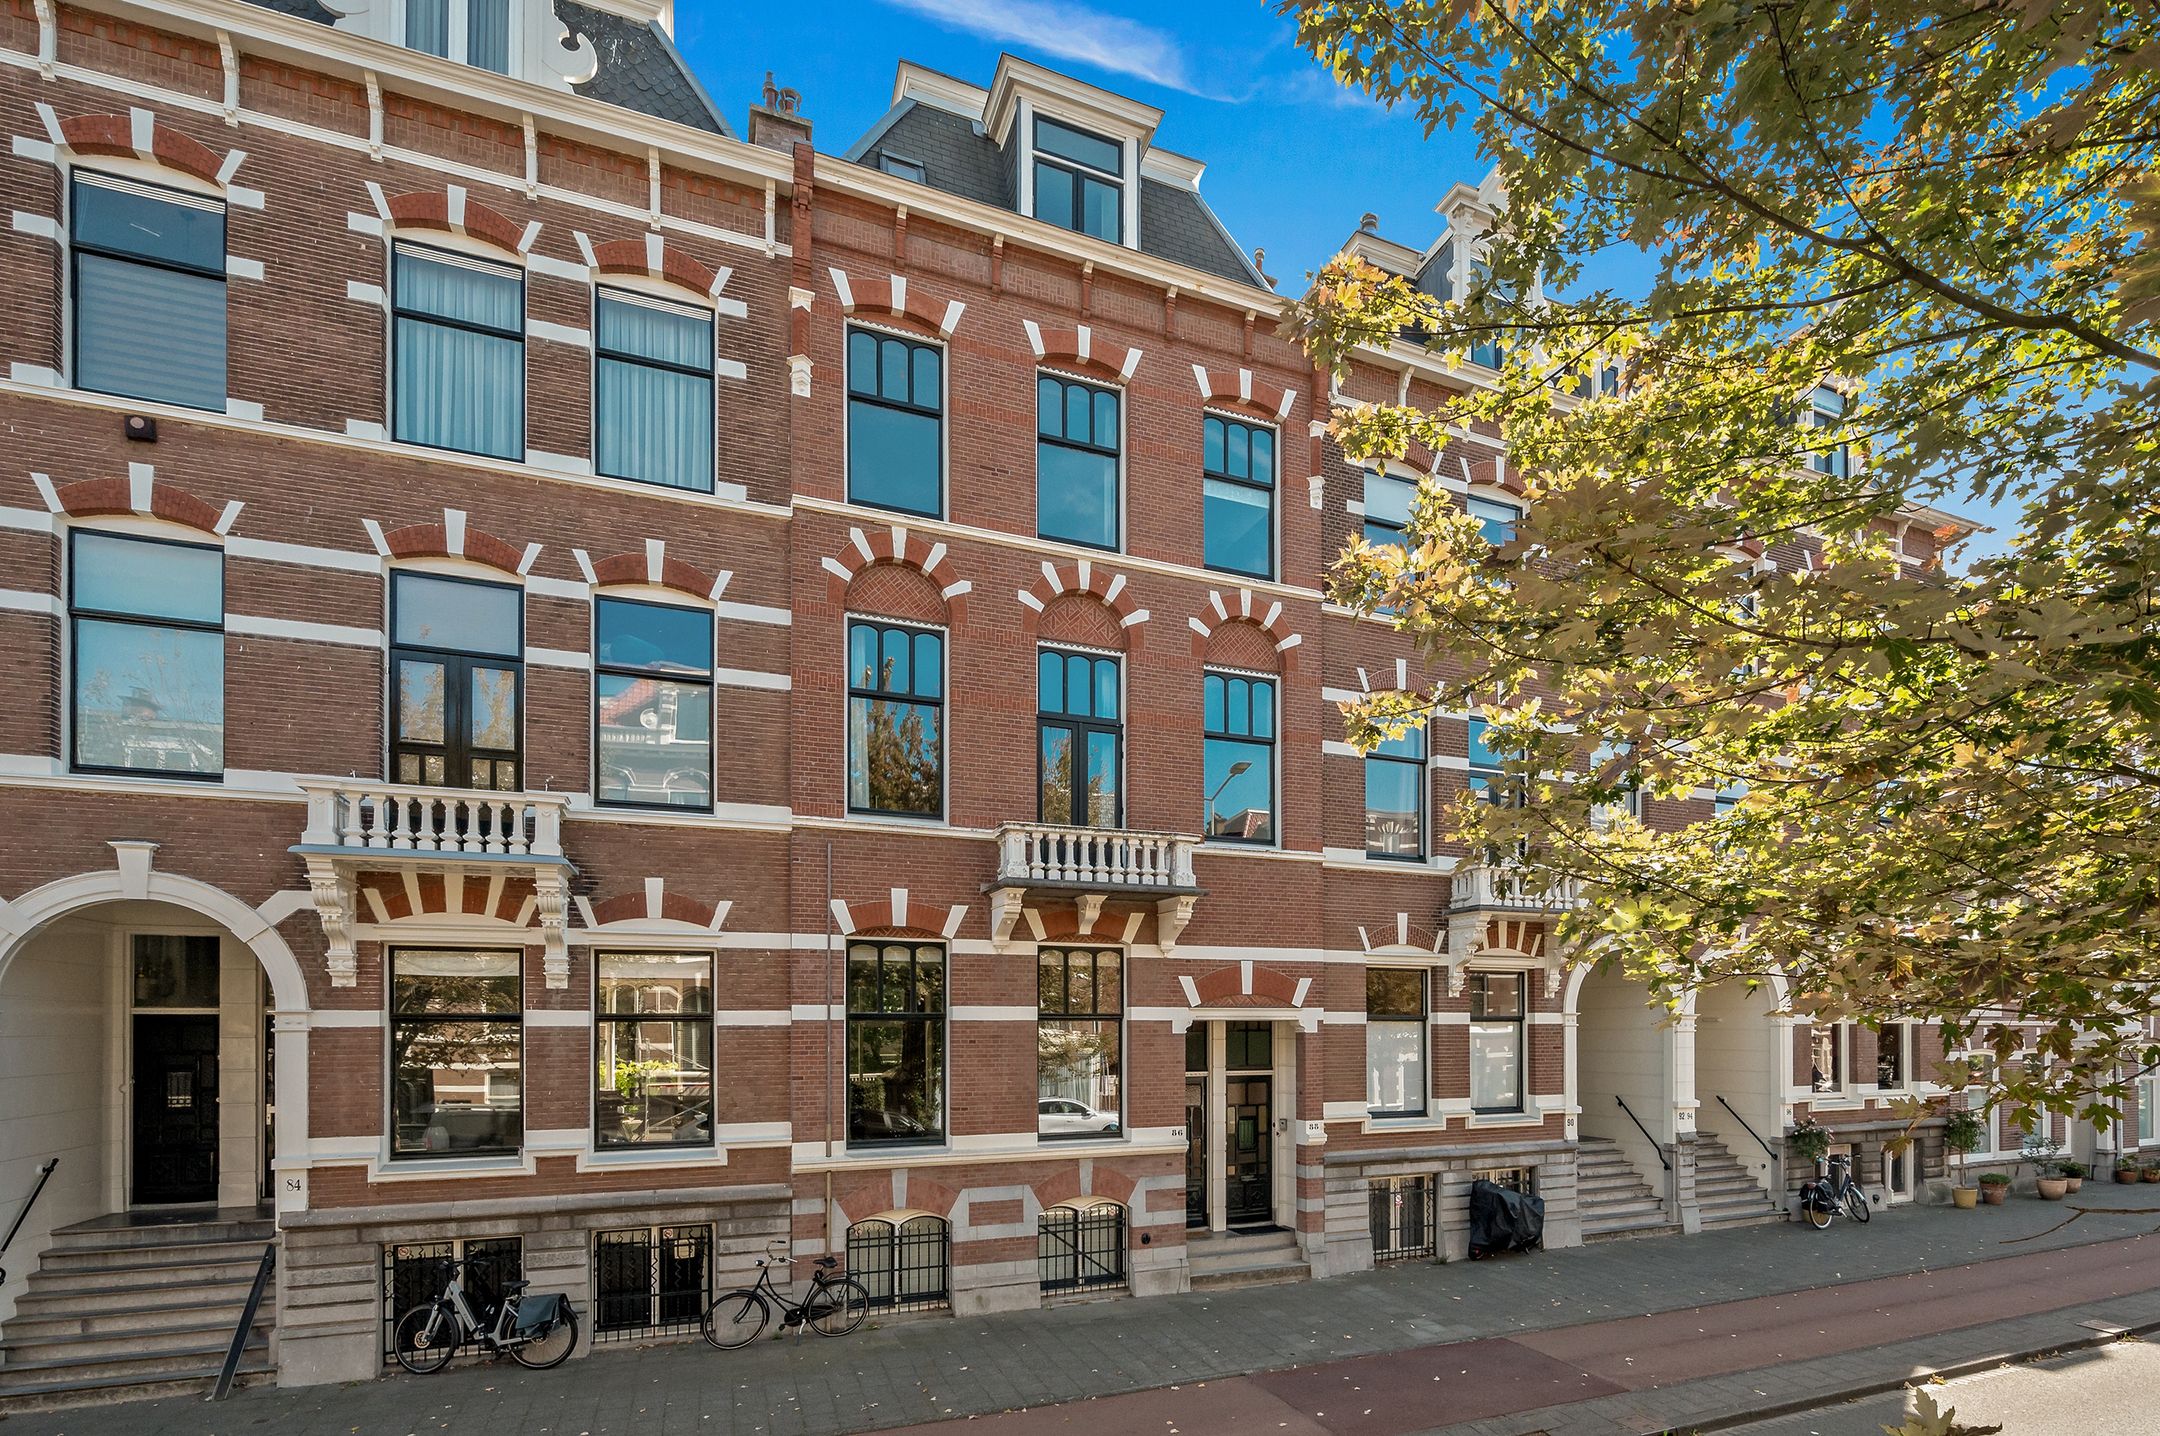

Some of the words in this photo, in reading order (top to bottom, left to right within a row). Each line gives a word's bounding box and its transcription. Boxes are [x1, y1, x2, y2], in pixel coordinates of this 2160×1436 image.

[1679, 1111, 1685, 1120] 92
[1687, 1112, 1693, 1120] 94
[1567, 1118, 1574, 1127] 90
[286, 1178, 301, 1192] 84
